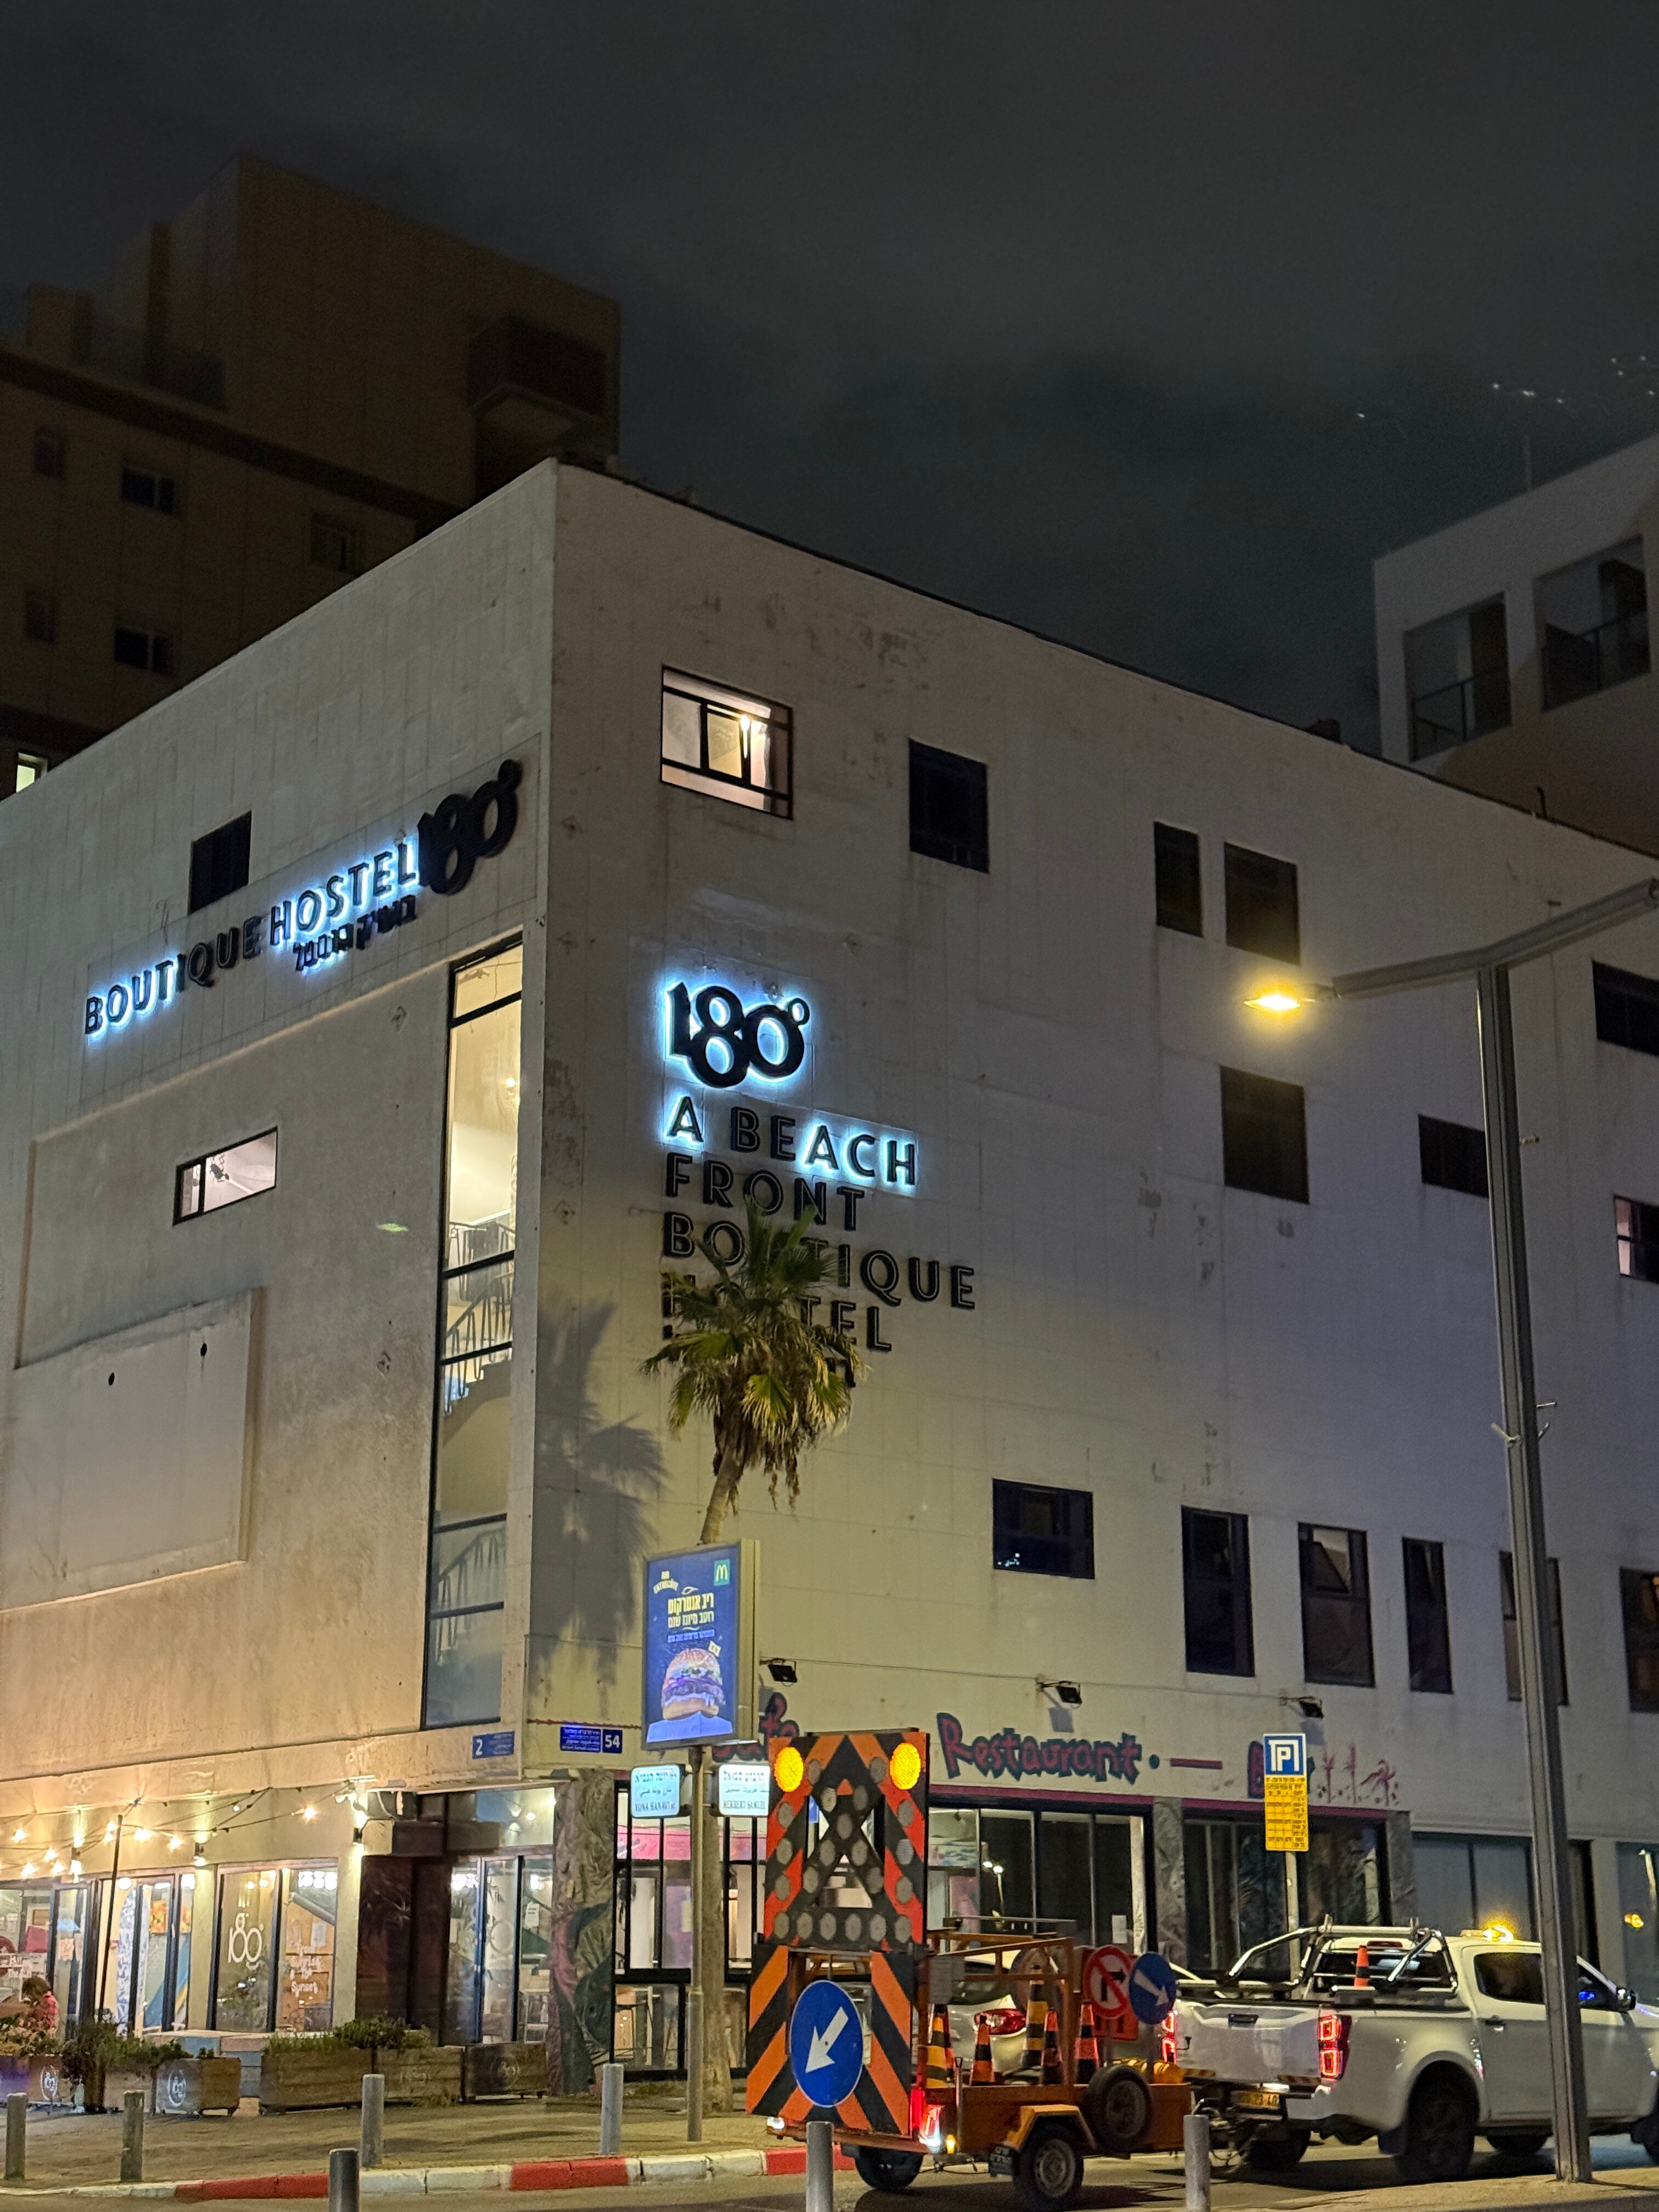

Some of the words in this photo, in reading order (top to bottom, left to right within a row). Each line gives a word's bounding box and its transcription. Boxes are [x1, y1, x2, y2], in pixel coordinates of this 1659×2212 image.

[84, 914, 264, 1036] BOUTIQUE
[269, 842, 419, 946] HOSTEL
[666, 1096, 703, 1143] A
[731, 1107, 916, 1186] BEACH
[665, 1152, 865, 1231] FRONT
[664, 1212, 975, 1310] BOTIQUE
[475, 1738, 483, 1756] 2
[605, 1734, 620, 1749] 54
